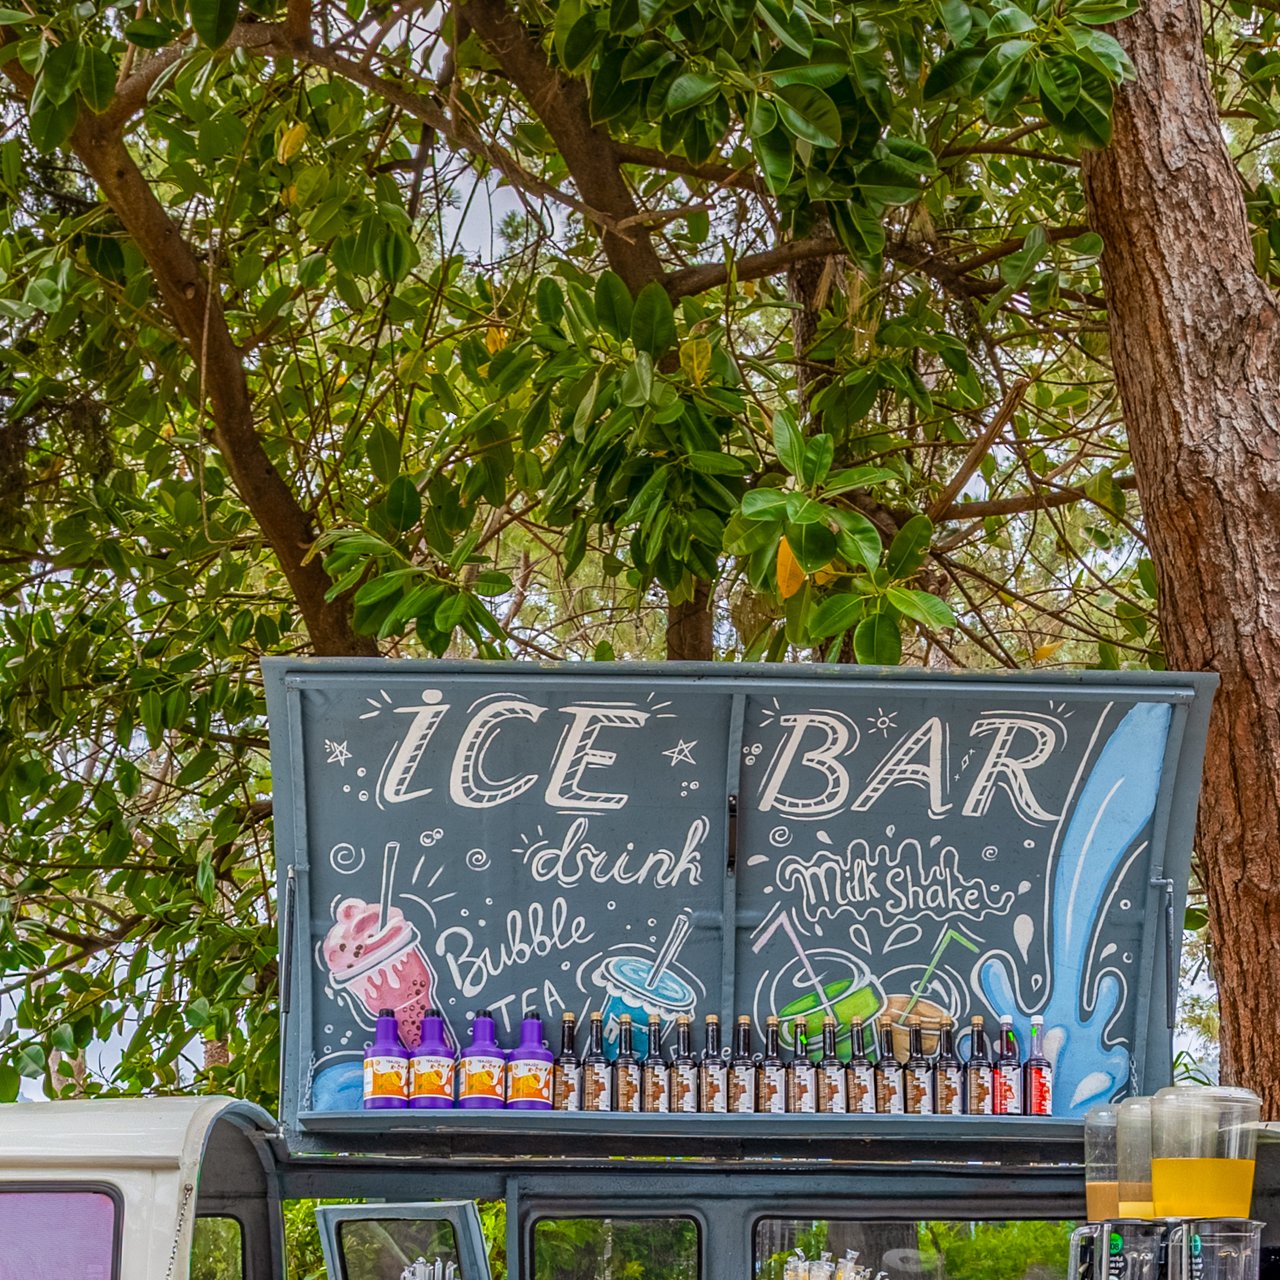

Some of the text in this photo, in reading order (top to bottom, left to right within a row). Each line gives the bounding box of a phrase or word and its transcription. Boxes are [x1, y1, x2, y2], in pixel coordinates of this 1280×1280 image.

[758, 713, 1060, 819] BAR
[530, 817, 710, 888] drink
[435, 896, 596, 998] Bubble
[486, 979, 566, 1033] TEA
